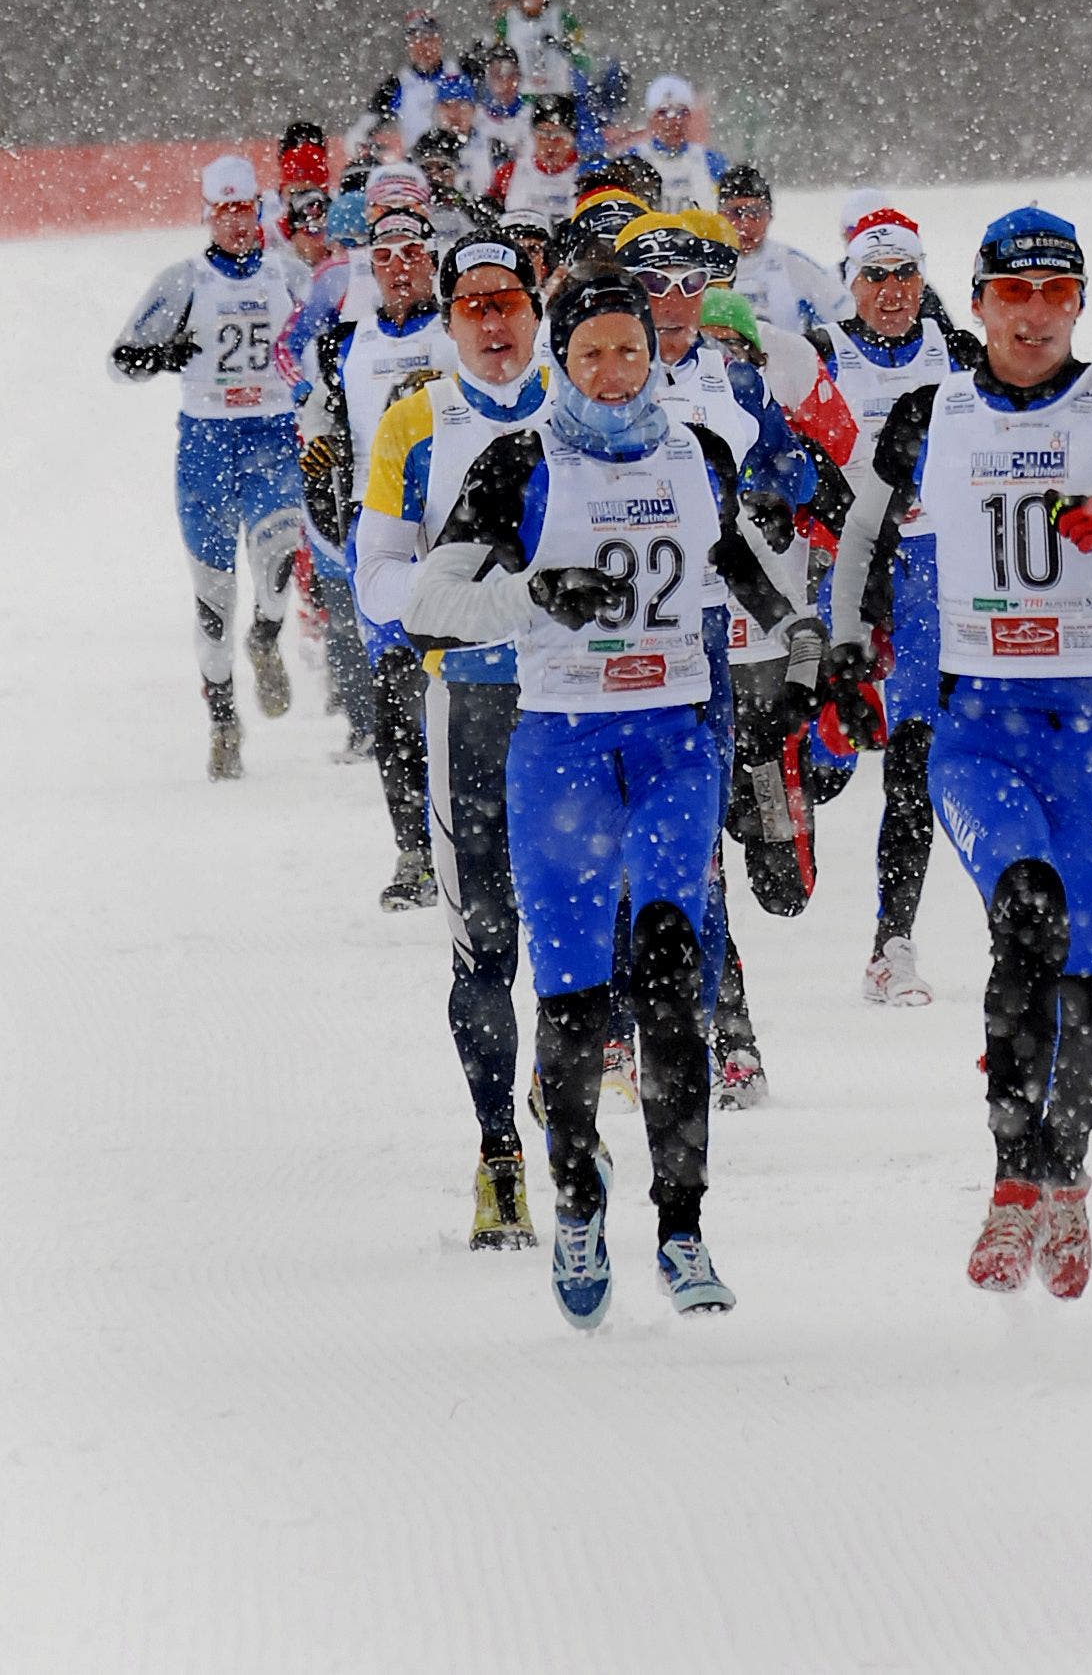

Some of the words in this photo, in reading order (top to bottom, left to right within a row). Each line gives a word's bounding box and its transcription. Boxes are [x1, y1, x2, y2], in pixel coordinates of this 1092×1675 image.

[217, 322, 271, 373] 25
[595, 536, 685, 632] 32
[982, 492, 1063, 592] 10
